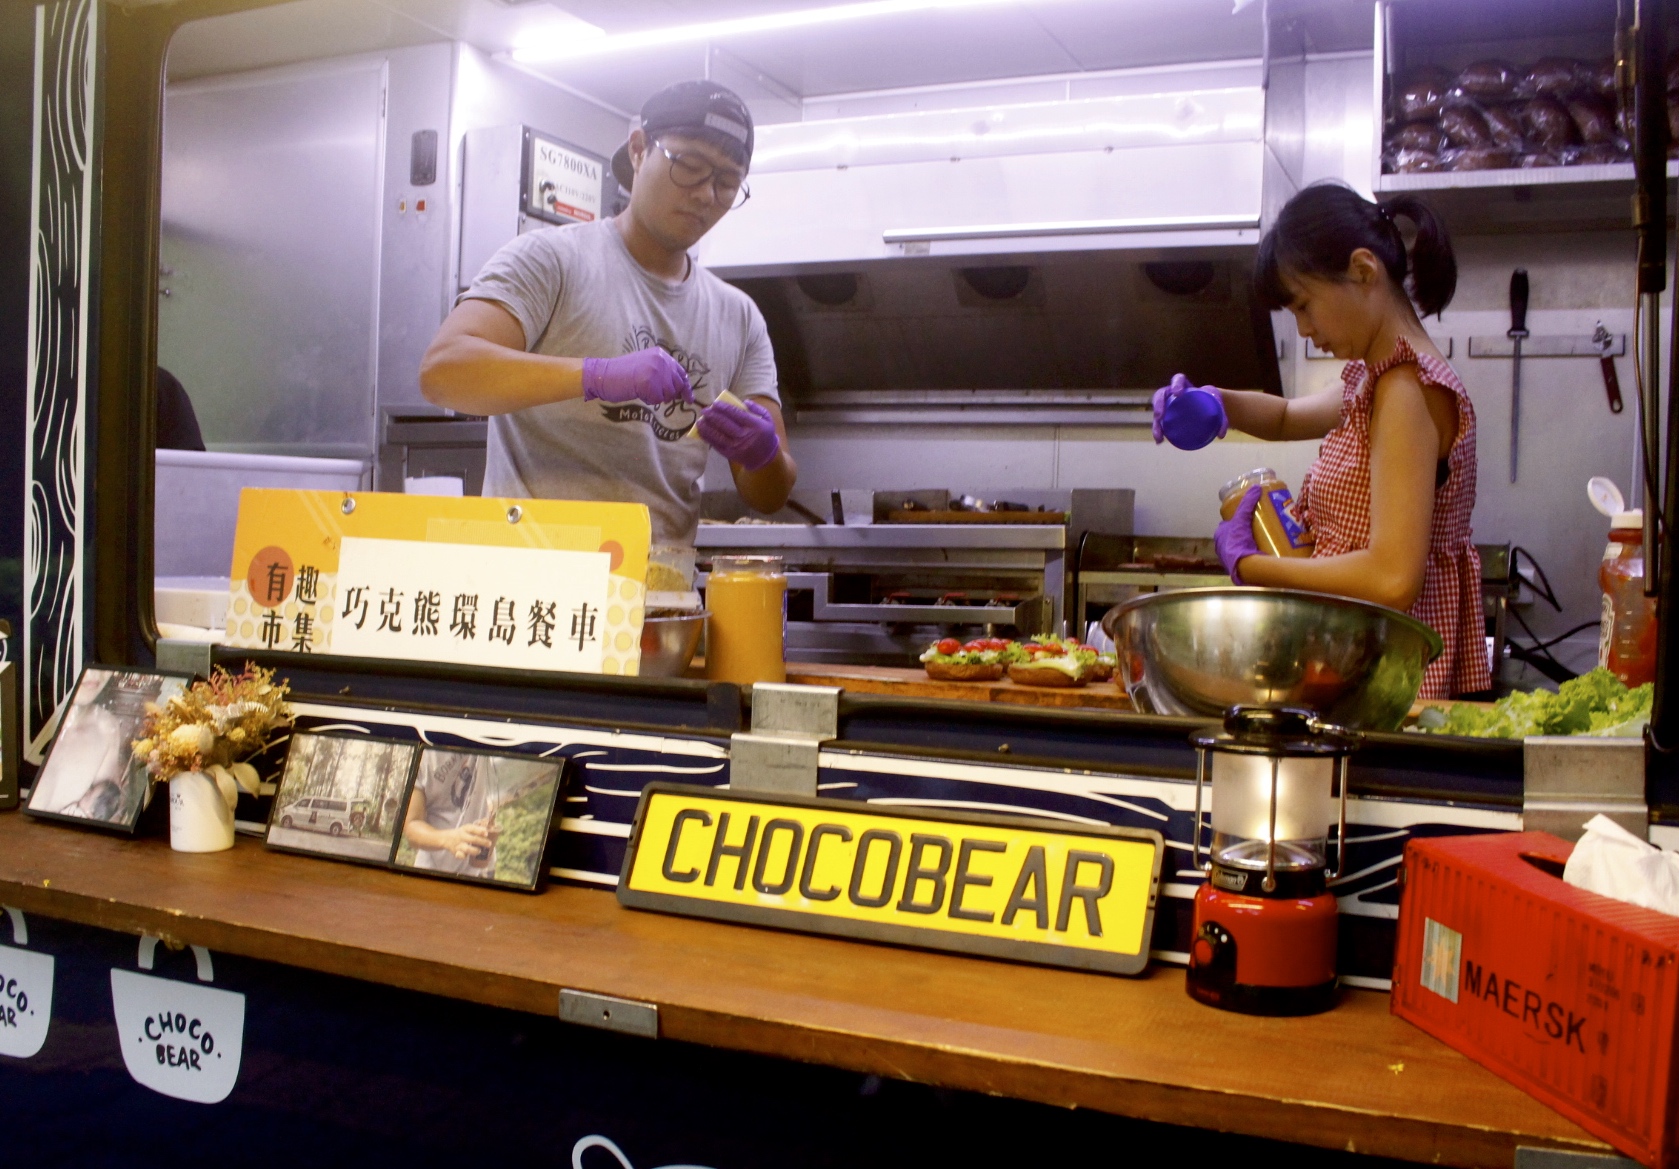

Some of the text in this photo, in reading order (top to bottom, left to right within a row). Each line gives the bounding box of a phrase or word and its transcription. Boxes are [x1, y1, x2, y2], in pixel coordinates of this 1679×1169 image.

[541, 146, 598, 181] SG7800XA
[266, 562, 319, 605] 有趣
[262, 610, 314, 653] 市集
[342, 584, 600, 652] 巧克熊環島餐車
[662, 808, 1115, 938] CHOCOBEAR
[1465, 961, 1587, 1055] MAERSK
[156, 1044, 202, 1071] BEAR
